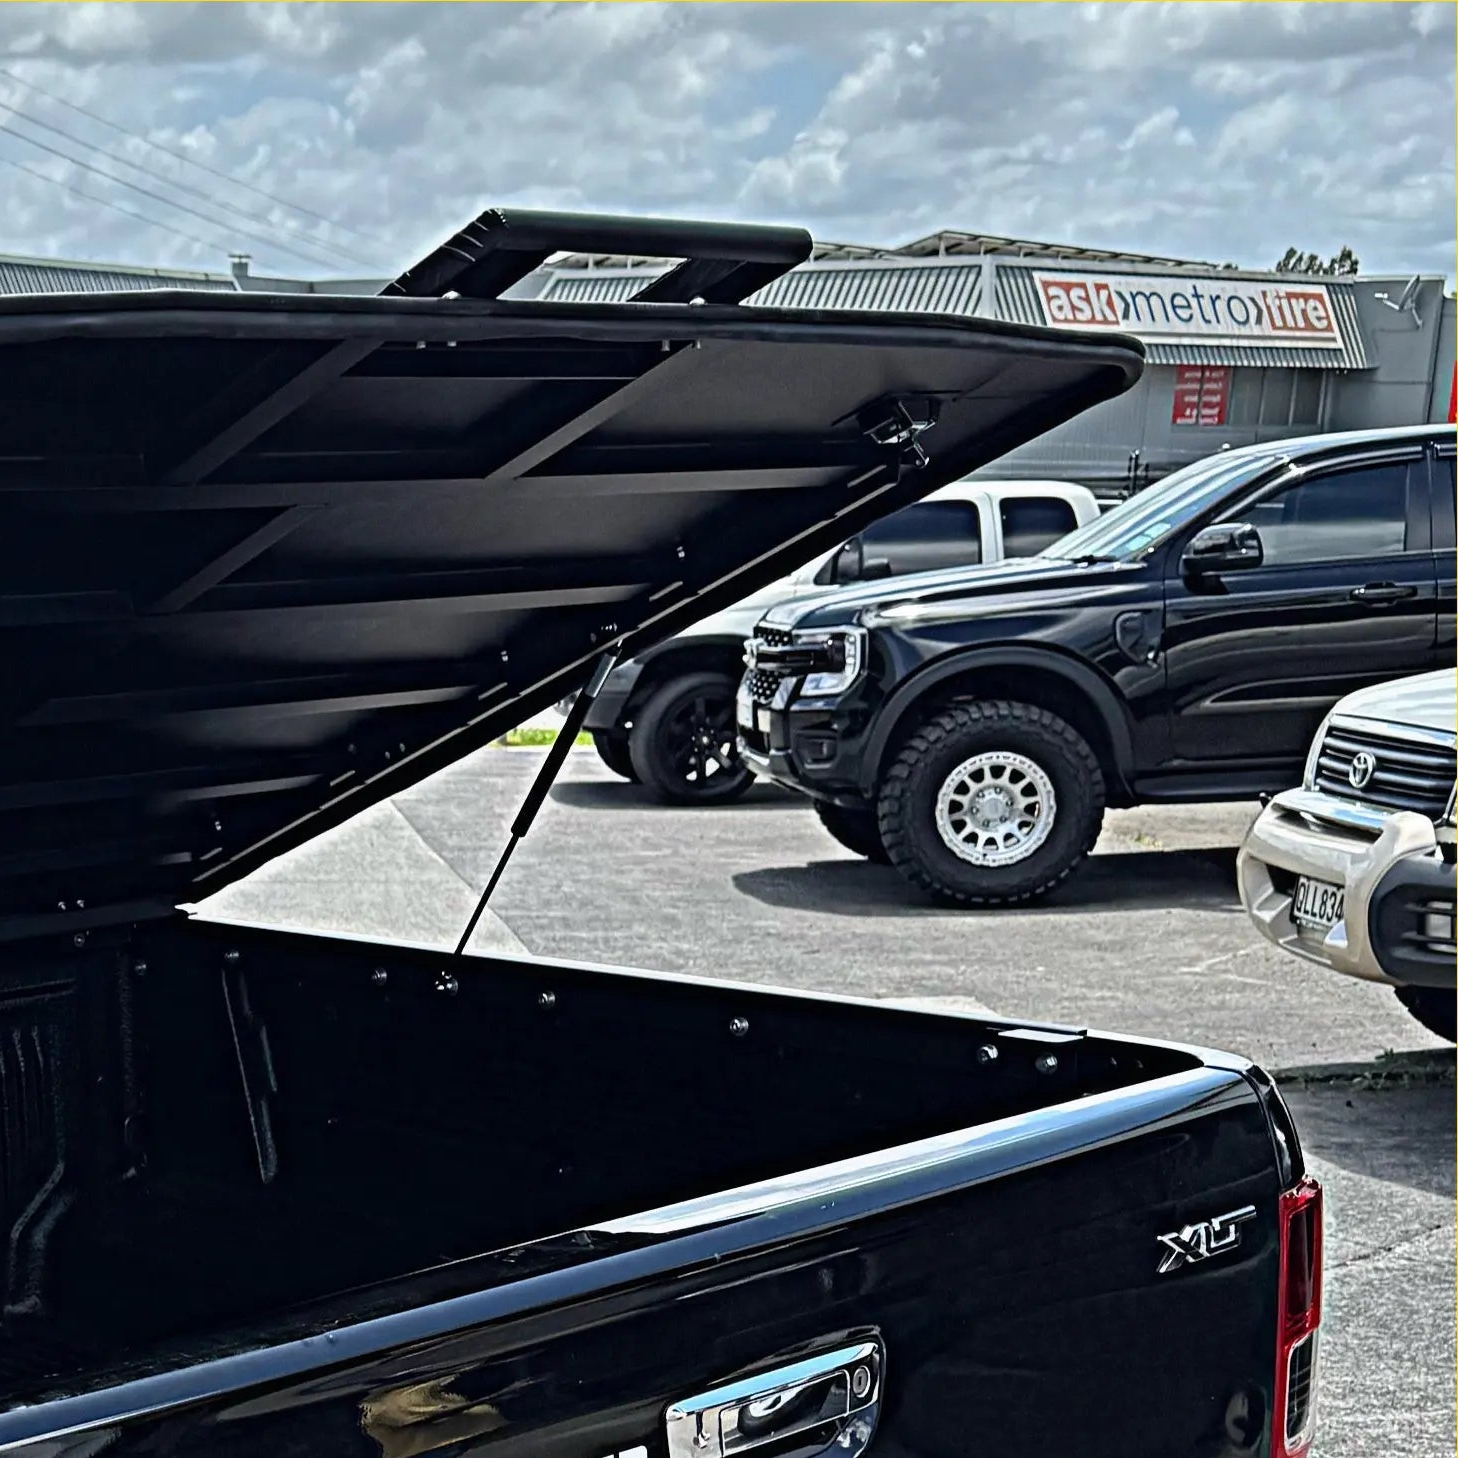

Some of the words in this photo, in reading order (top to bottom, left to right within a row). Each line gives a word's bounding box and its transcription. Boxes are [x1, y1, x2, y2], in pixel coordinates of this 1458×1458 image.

[1044, 282, 1117, 324] ask
[1130, 283, 1250, 327] metro
[1266, 290, 1330, 331] fire
[1156, 1205, 1257, 1273] XLT
